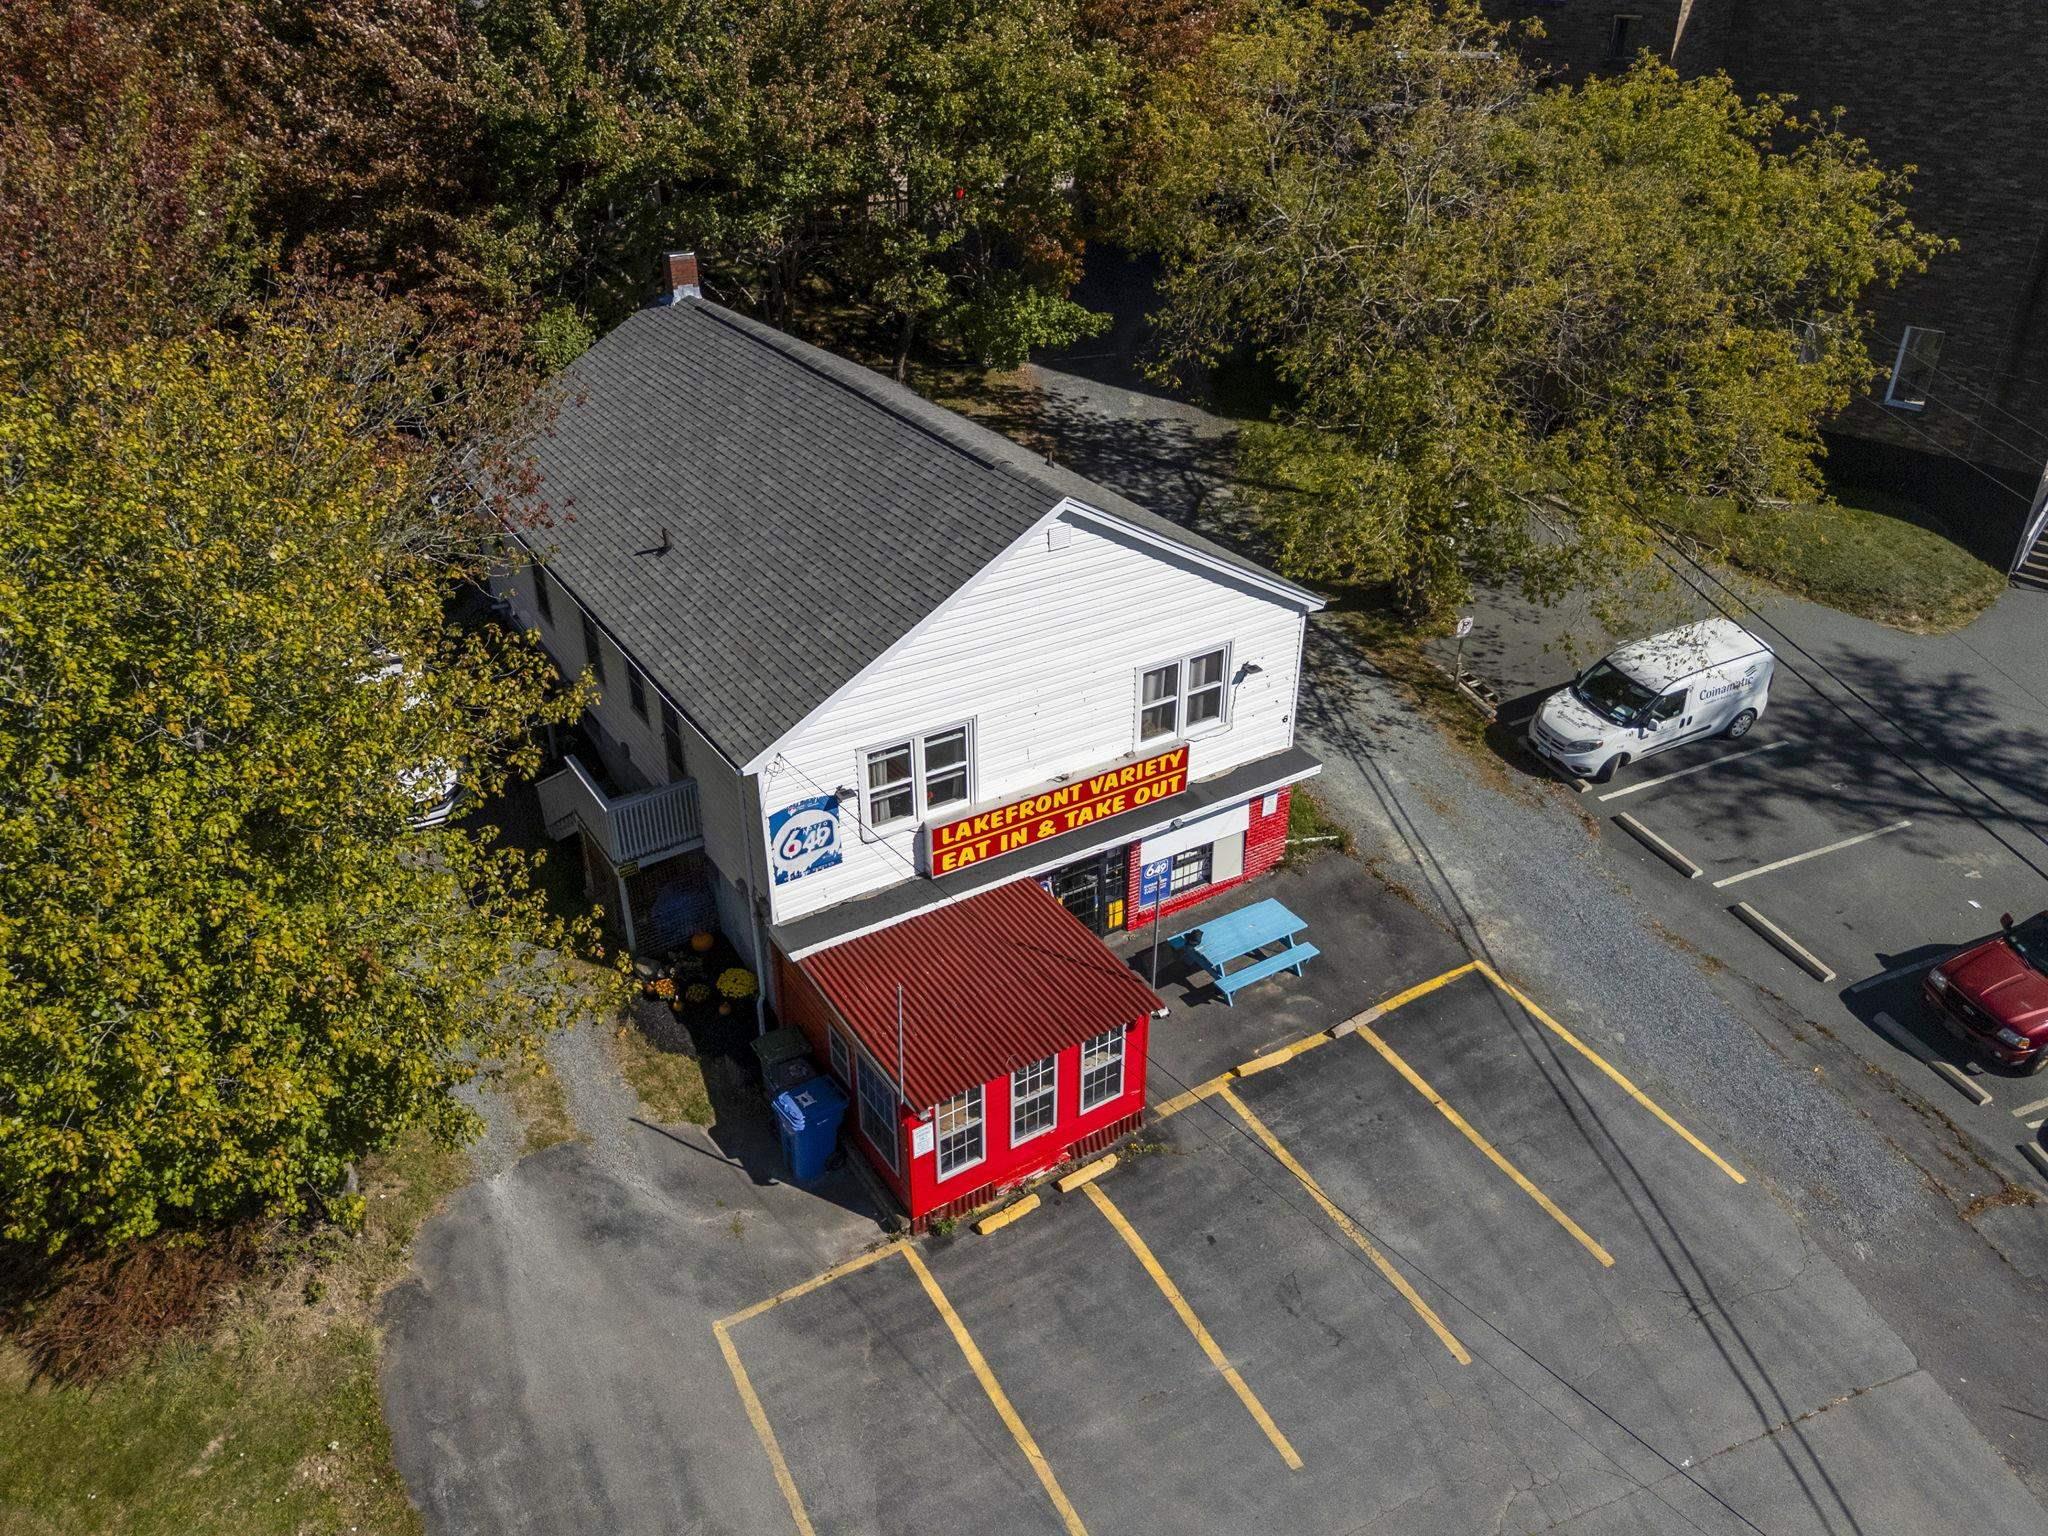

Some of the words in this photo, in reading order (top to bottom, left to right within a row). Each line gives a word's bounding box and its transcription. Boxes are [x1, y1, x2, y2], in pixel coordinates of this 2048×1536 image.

[1699, 677, 1754, 701] Coinamatic
[942, 784, 1083, 845] LAKEFRONT
[1089, 750, 1184, 794] VARIETY
[942, 840, 988, 871] EAT
[1001, 828, 1028, 851] IN
[1038, 819, 1057, 838] &
[1065, 794, 1126, 829] TAKE
[1134, 775, 1182, 805] OUT
